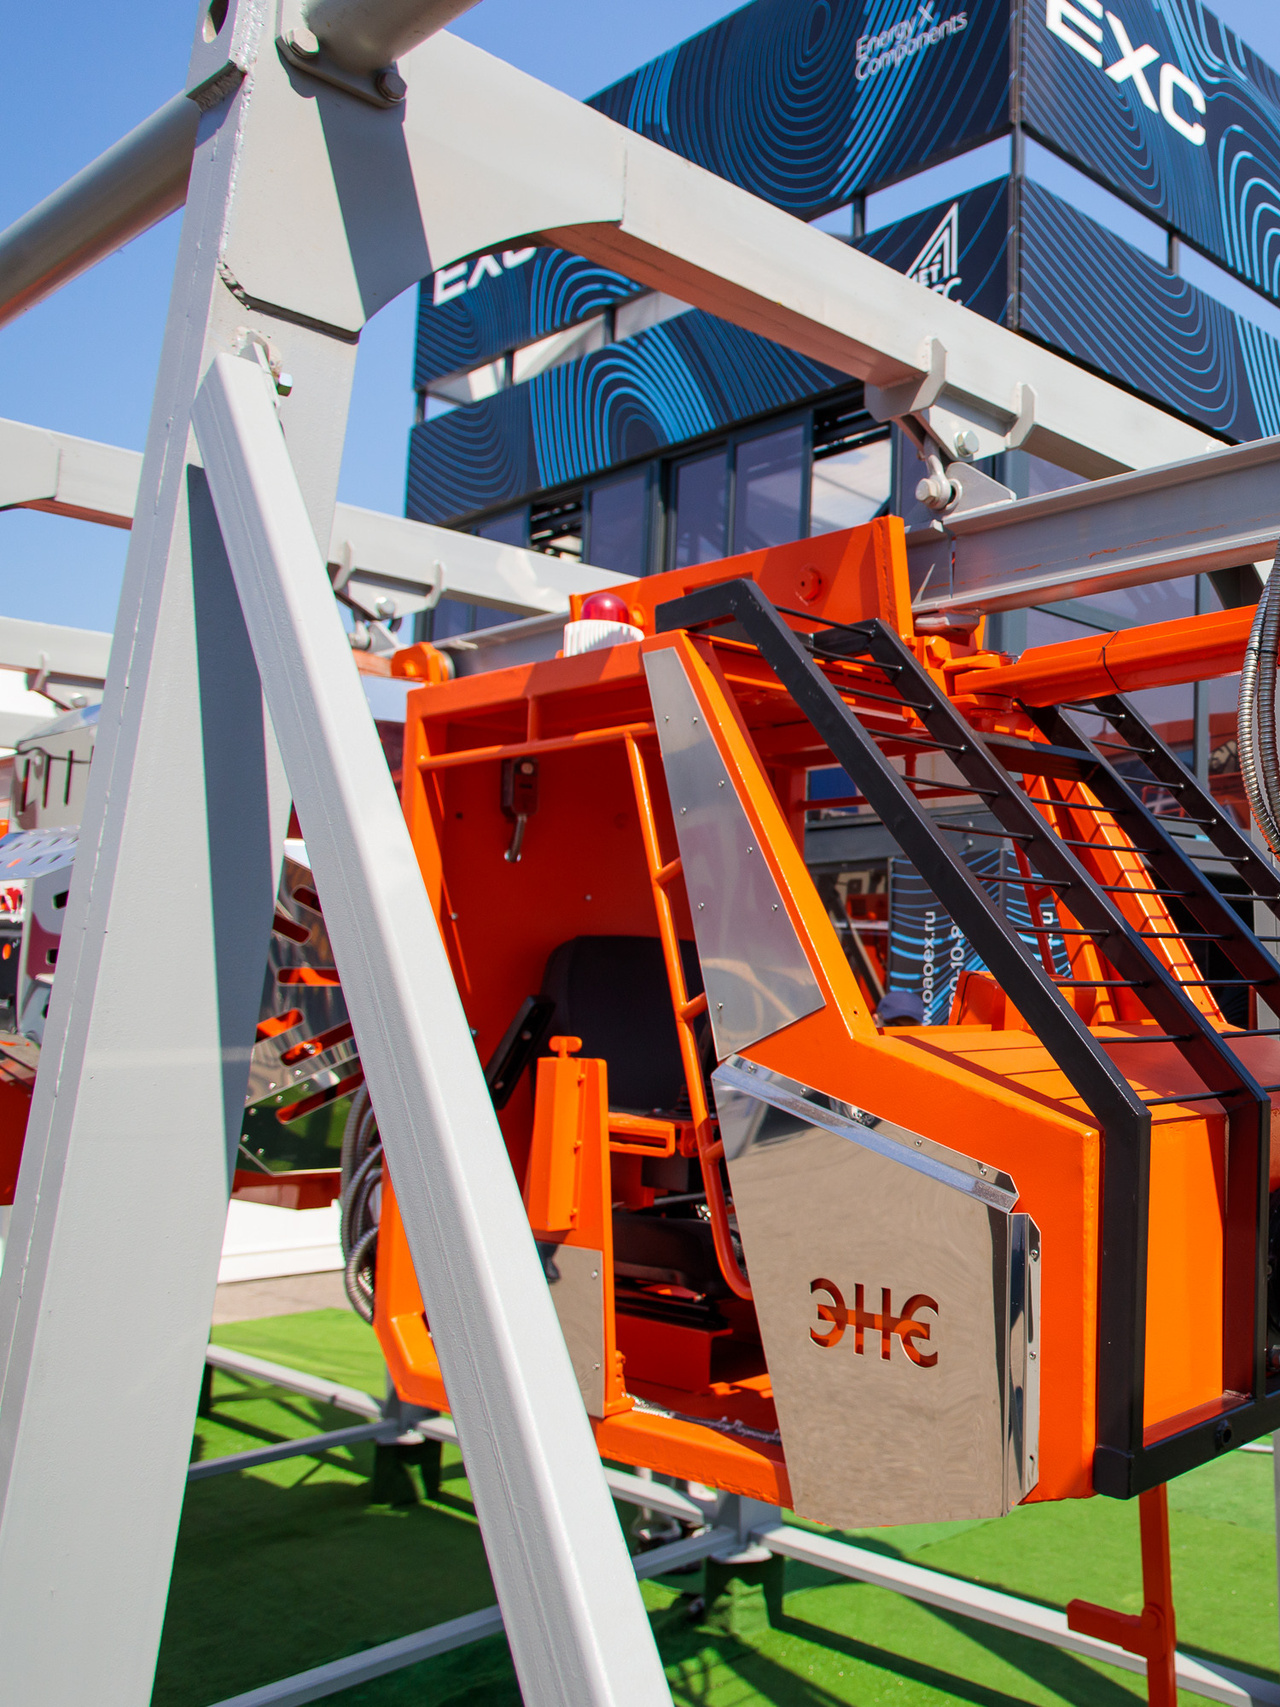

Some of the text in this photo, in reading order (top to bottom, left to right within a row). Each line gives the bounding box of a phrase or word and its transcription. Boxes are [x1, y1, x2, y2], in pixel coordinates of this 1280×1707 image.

[855, 11, 968, 81] Components
[856, 15, 918, 60] Energy
[1046, 0, 1206, 146] EXC
